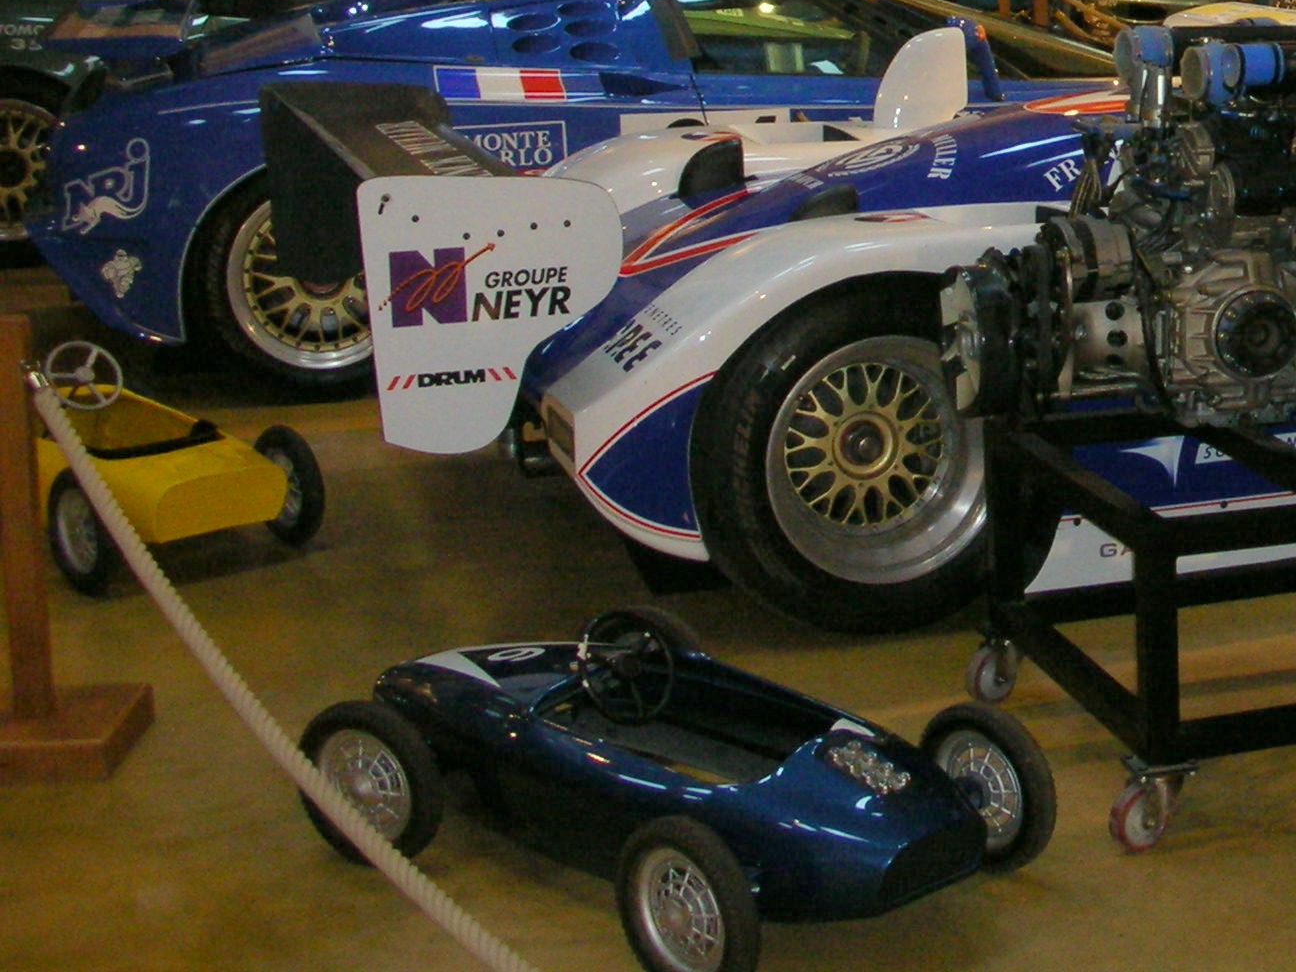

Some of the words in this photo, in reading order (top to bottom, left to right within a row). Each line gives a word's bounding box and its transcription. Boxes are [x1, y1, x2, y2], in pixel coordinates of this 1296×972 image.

[485, 266, 569, 289] GROUPE
[472, 286, 572, 322] NEYR
[417, 369, 486, 388] DRUM
